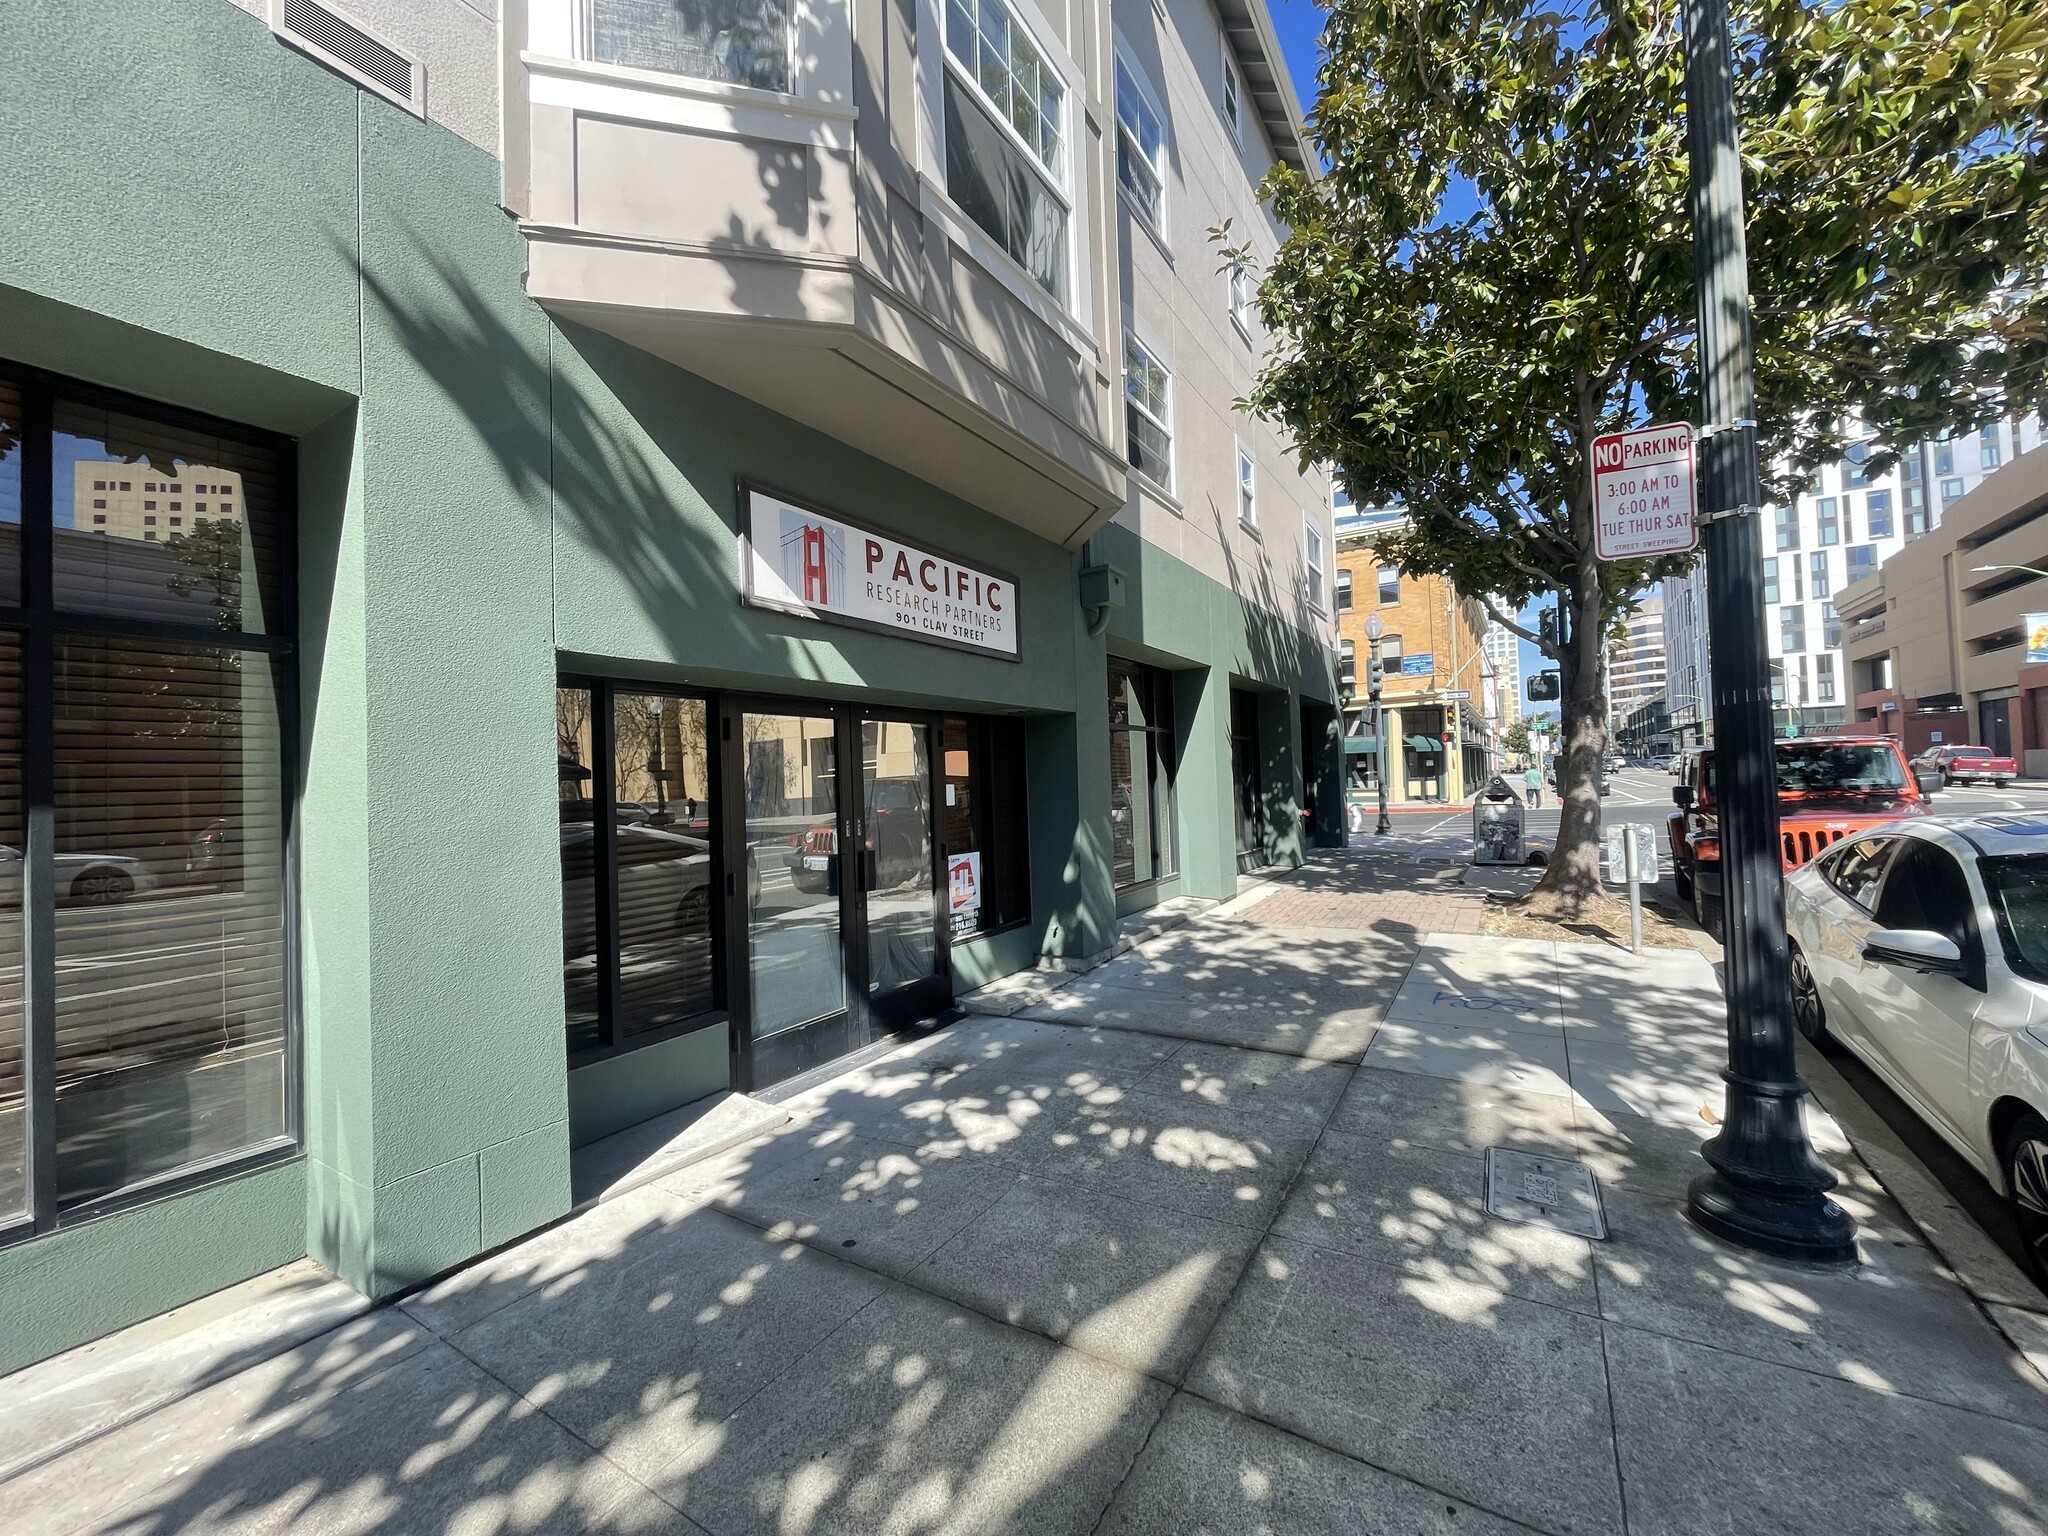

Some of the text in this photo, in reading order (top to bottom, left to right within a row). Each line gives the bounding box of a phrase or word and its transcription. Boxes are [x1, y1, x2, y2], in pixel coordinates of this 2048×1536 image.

[1595, 435, 1687, 468] NO PARKING
[1607, 474, 1679, 498] 3:00 AM TO
[1617, 495, 1670, 515] 6:00 AM
[1602, 512, 1689, 537] TUE THUR SAT
[1614, 537, 1679, 552] STREET SWEEPING
[865, 538, 1002, 612] PACIFIC
[866, 581, 1002, 632] RESEARCH PARTNERS
[895, 612, 985, 642] 901 CLAY STREET
